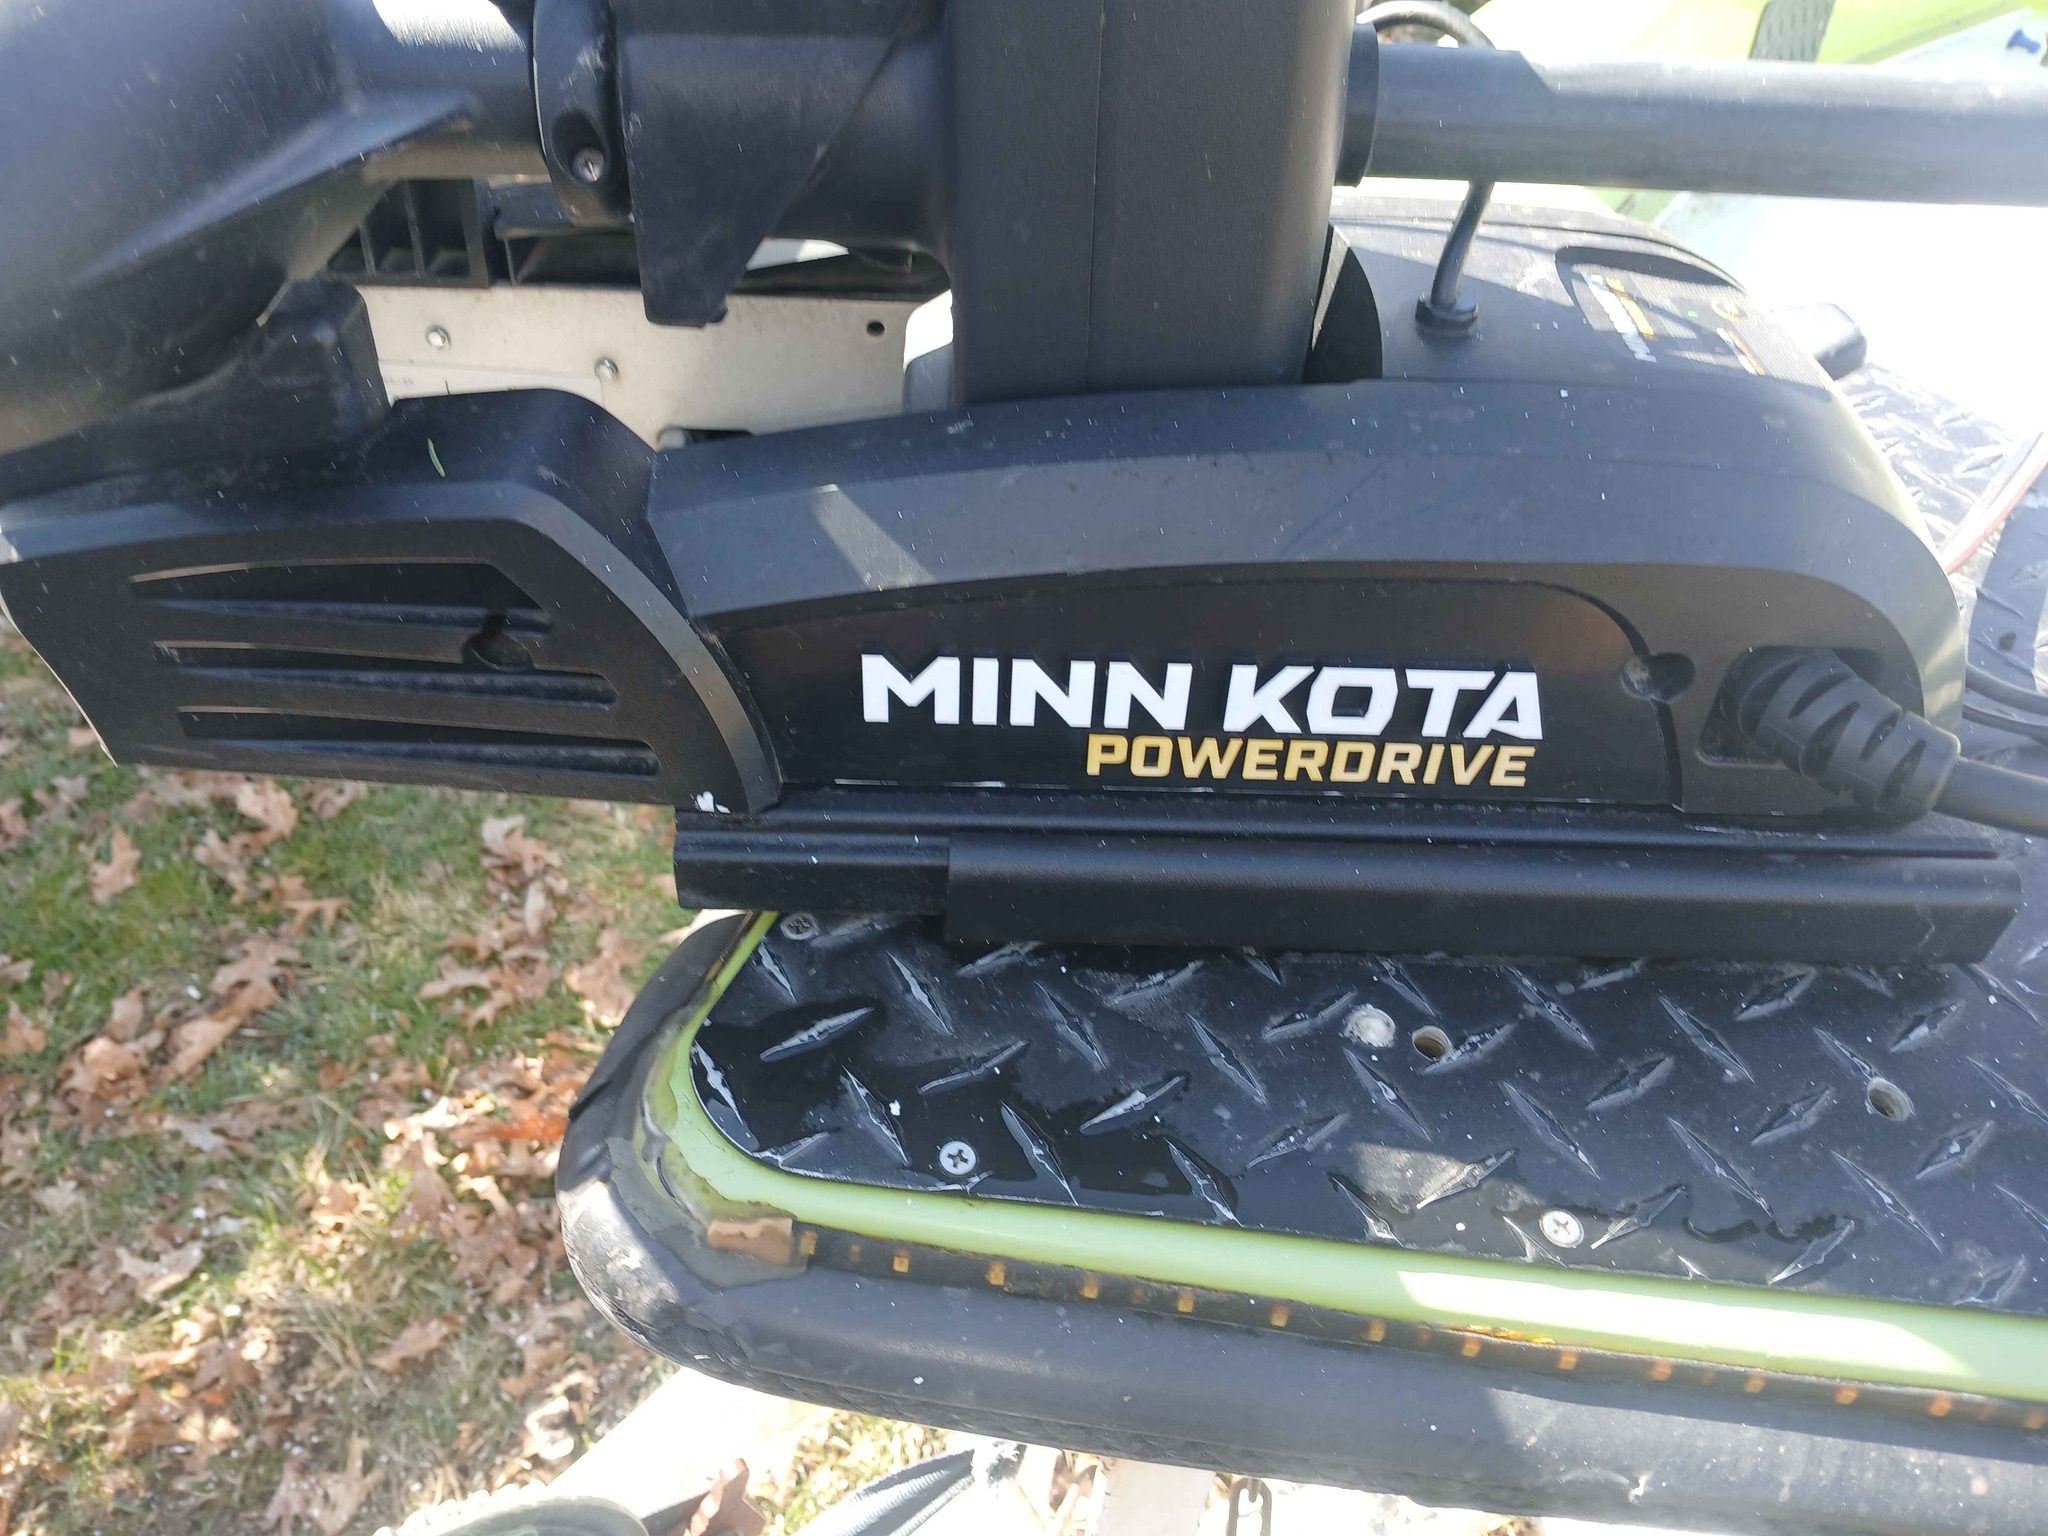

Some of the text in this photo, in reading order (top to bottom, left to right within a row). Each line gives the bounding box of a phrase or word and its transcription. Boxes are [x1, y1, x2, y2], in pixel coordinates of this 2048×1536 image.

[861, 653, 1543, 740] MINN KOTA
[1086, 733, 1536, 787] POWERDRIVE
